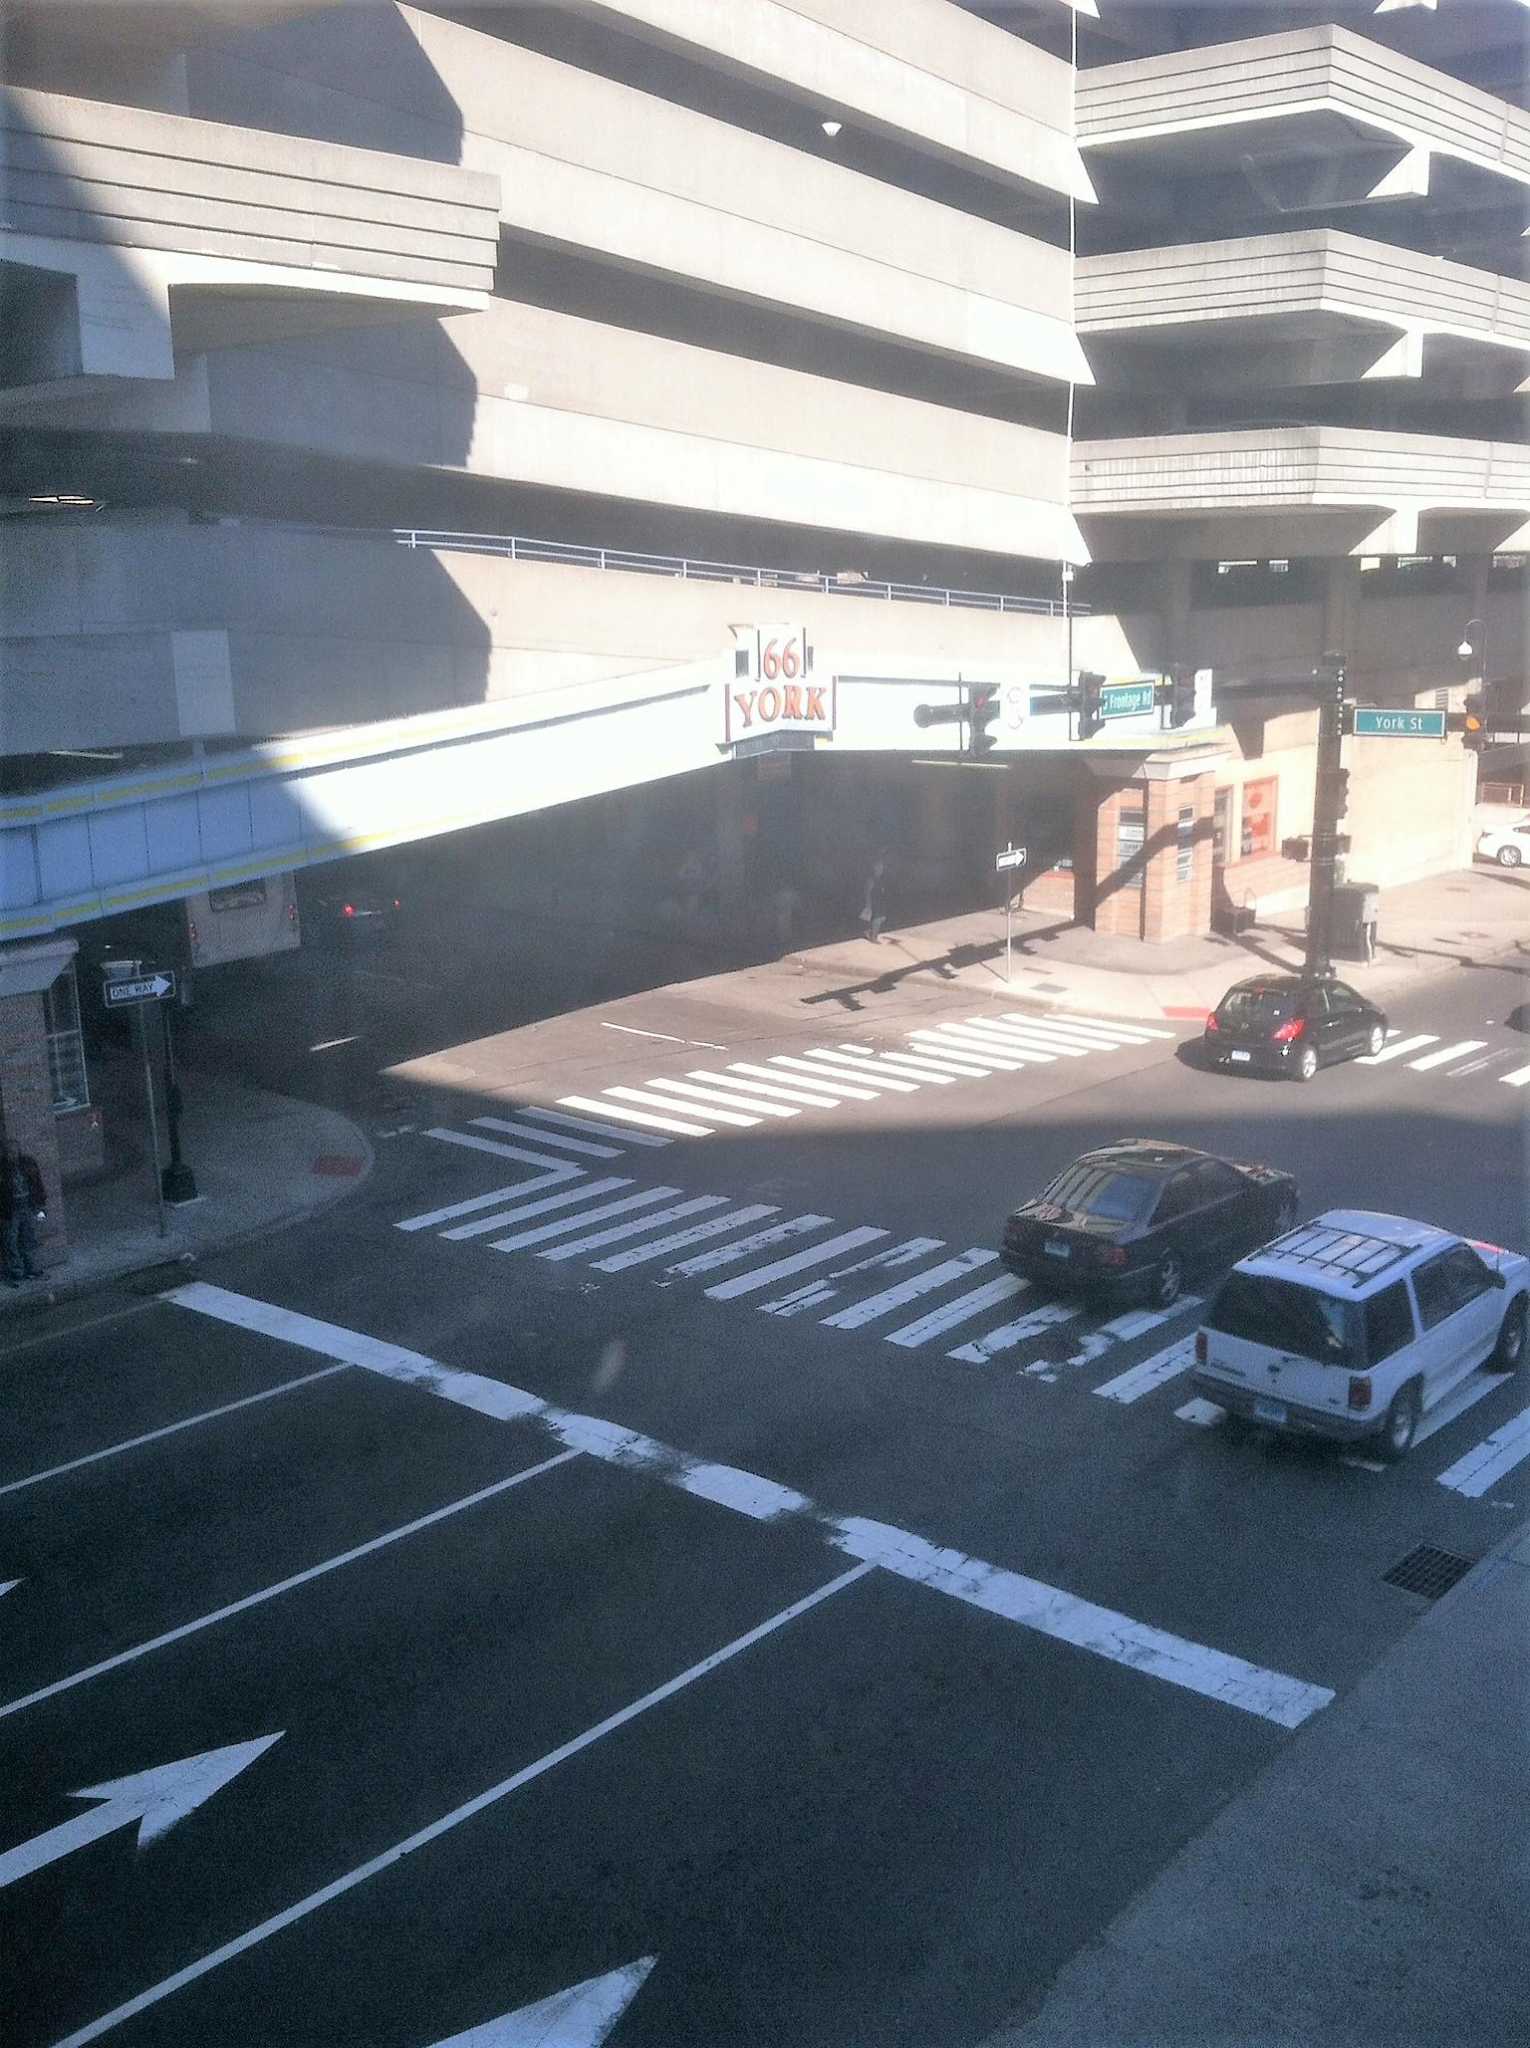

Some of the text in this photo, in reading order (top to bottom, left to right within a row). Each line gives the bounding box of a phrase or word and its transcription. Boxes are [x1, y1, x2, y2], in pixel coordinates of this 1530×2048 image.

[763, 637, 801, 680] 66
[733, 684, 827, 728] YORK
[1110, 692, 1141, 712] Frontage
[1375, 716, 1423, 731] York St
[112, 982, 153, 999] ONE WAY
